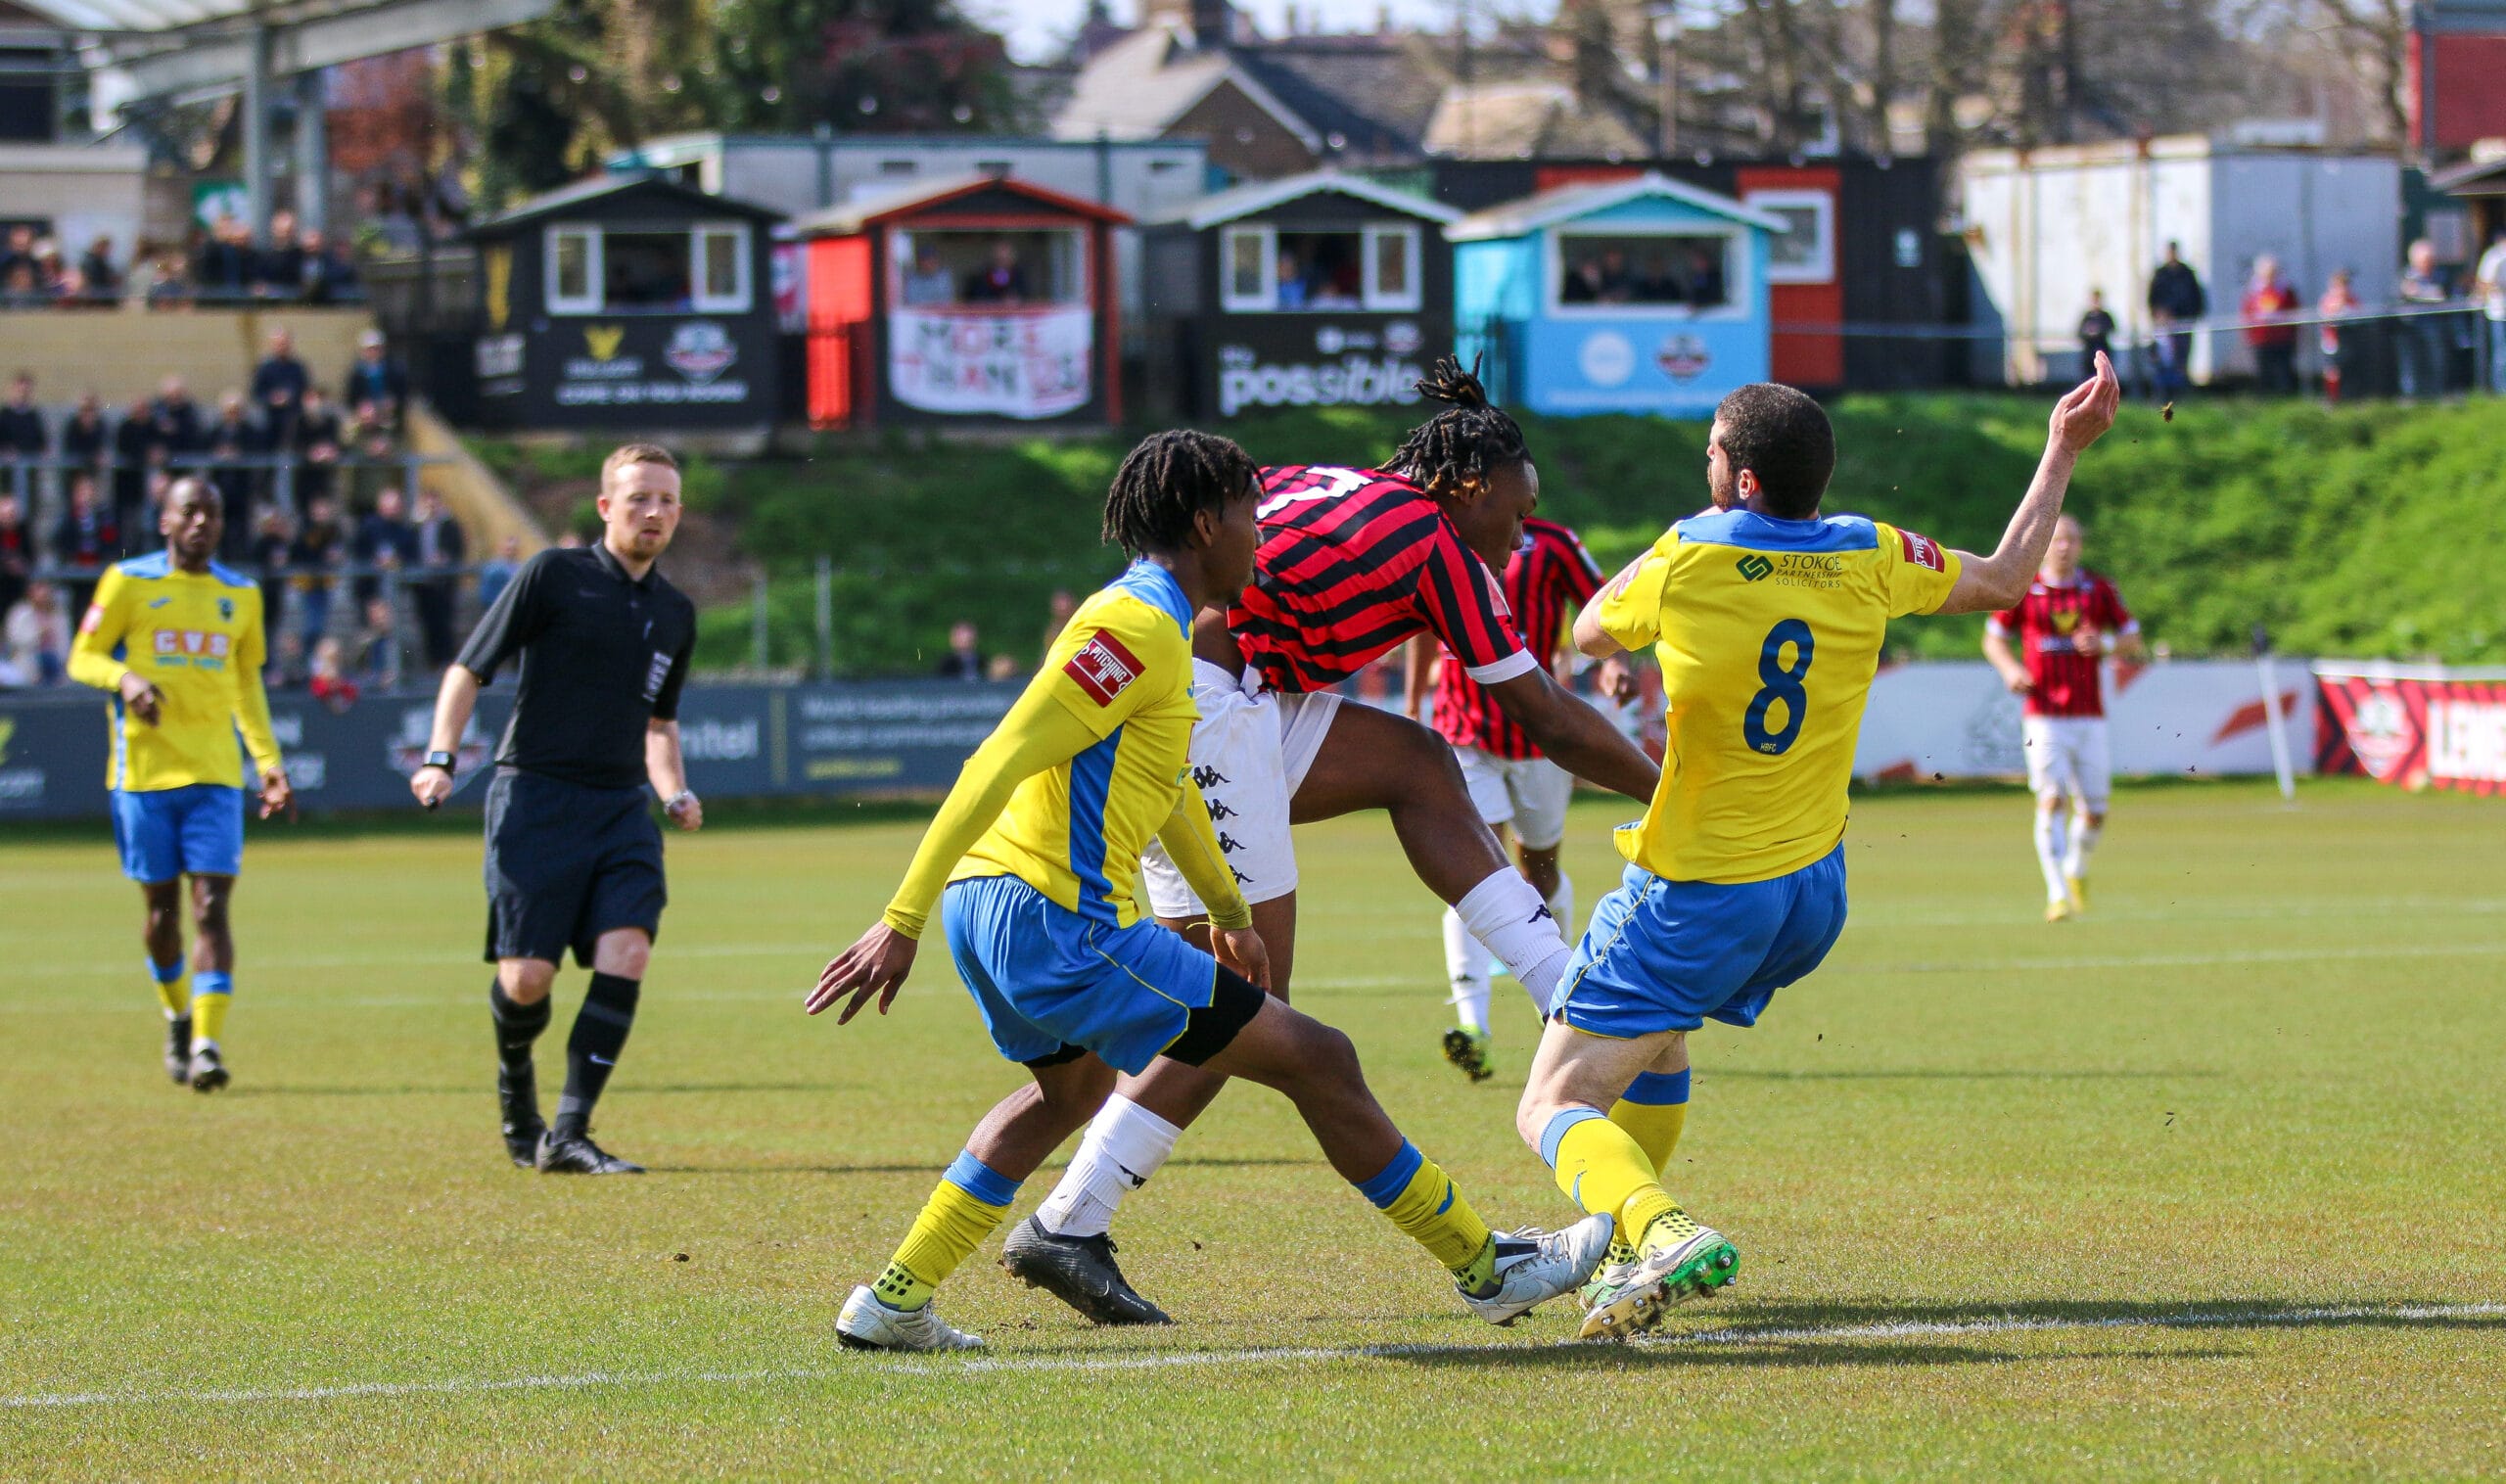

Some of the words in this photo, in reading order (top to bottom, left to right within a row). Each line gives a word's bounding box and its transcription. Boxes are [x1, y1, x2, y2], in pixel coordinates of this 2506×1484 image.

[1220, 353, 1425, 416] possible
[1776, 569, 1842, 580] PARTNERSHIP
[1780, 554, 1842, 572] STOKOE
[1776, 578, 1840, 588] SOLICITORS
[154, 629, 230, 657] CVS
[1089, 646, 1128, 682] PITCHING
[1094, 666, 1111, 683] IN
[1743, 618, 1815, 755] 8
